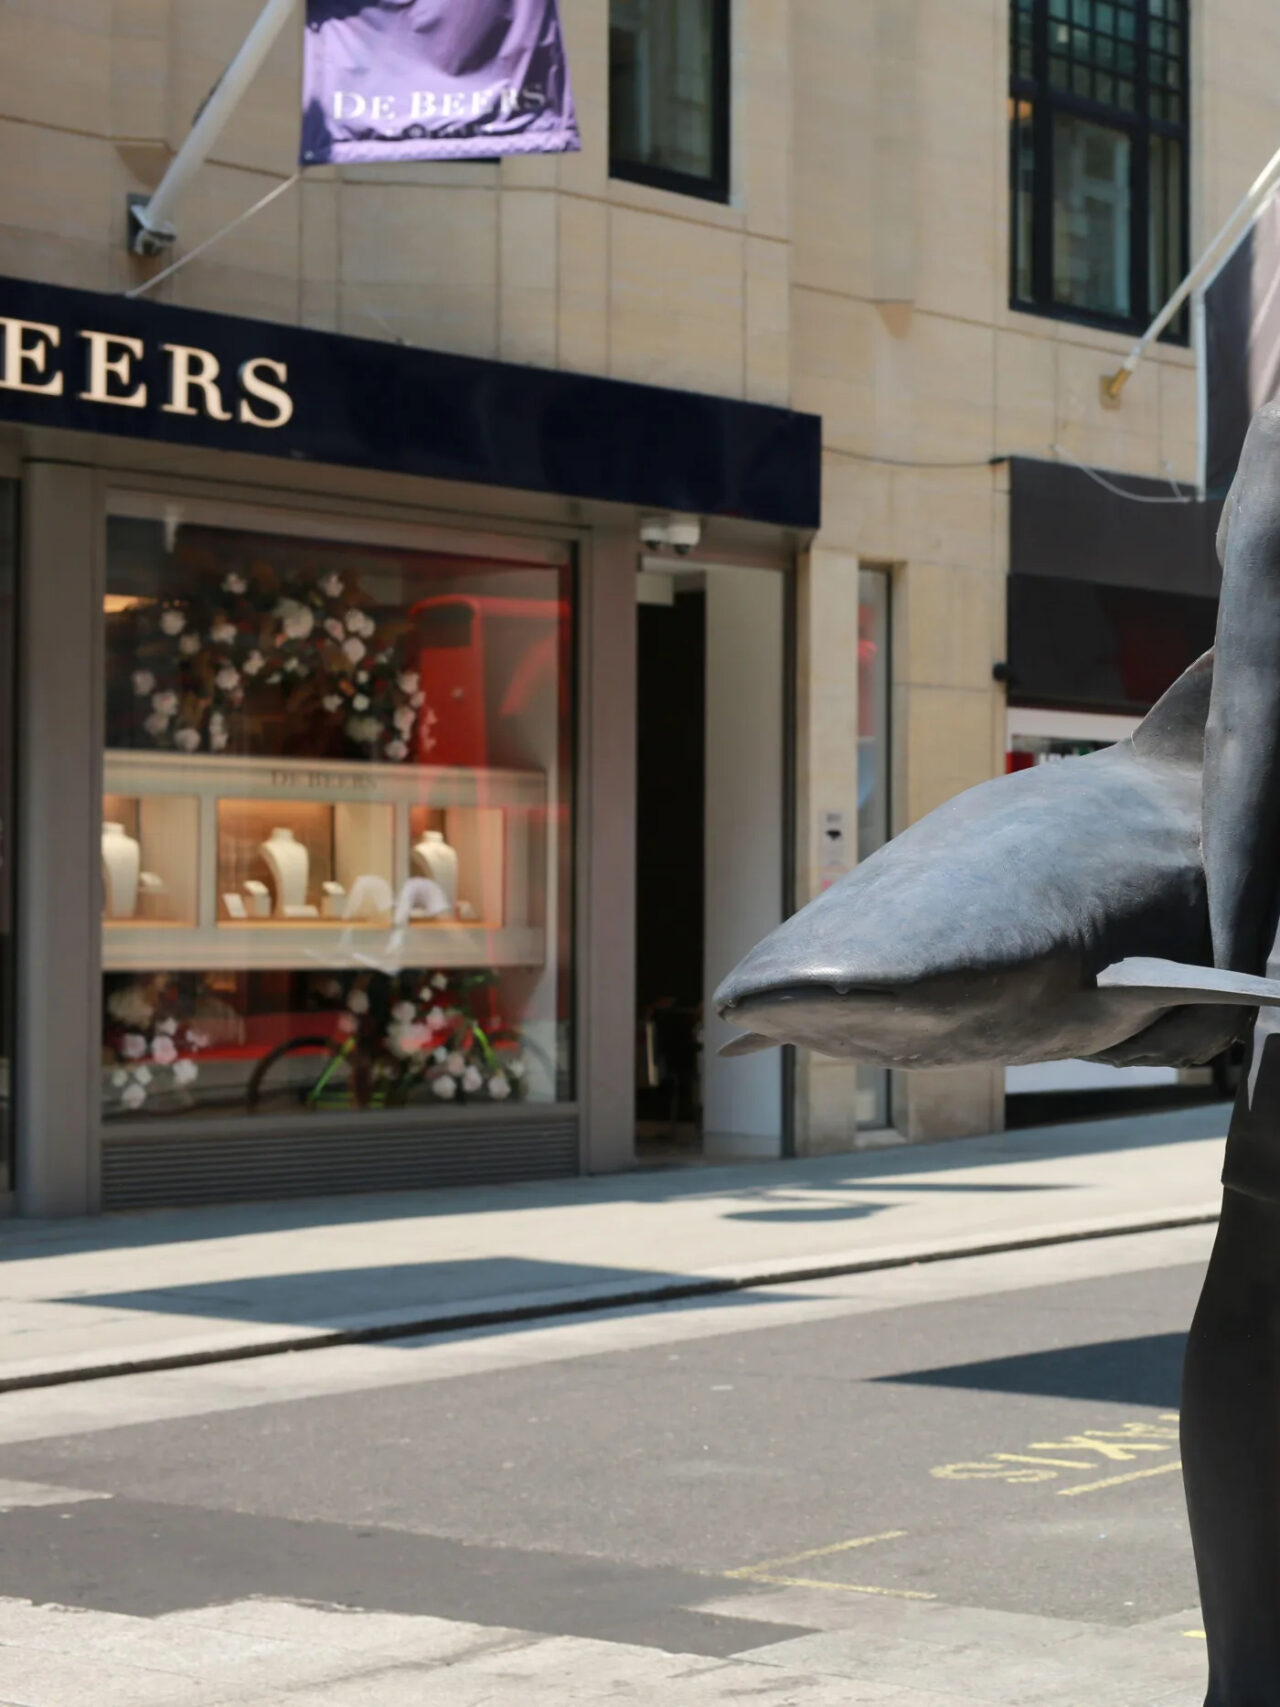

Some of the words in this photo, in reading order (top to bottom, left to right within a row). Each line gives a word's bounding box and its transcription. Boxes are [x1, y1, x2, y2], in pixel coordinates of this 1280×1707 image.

[332, 90, 397, 121] DE
[409, 83, 548, 121] BEERS
[928, 1413, 1180, 1483] AXIS
